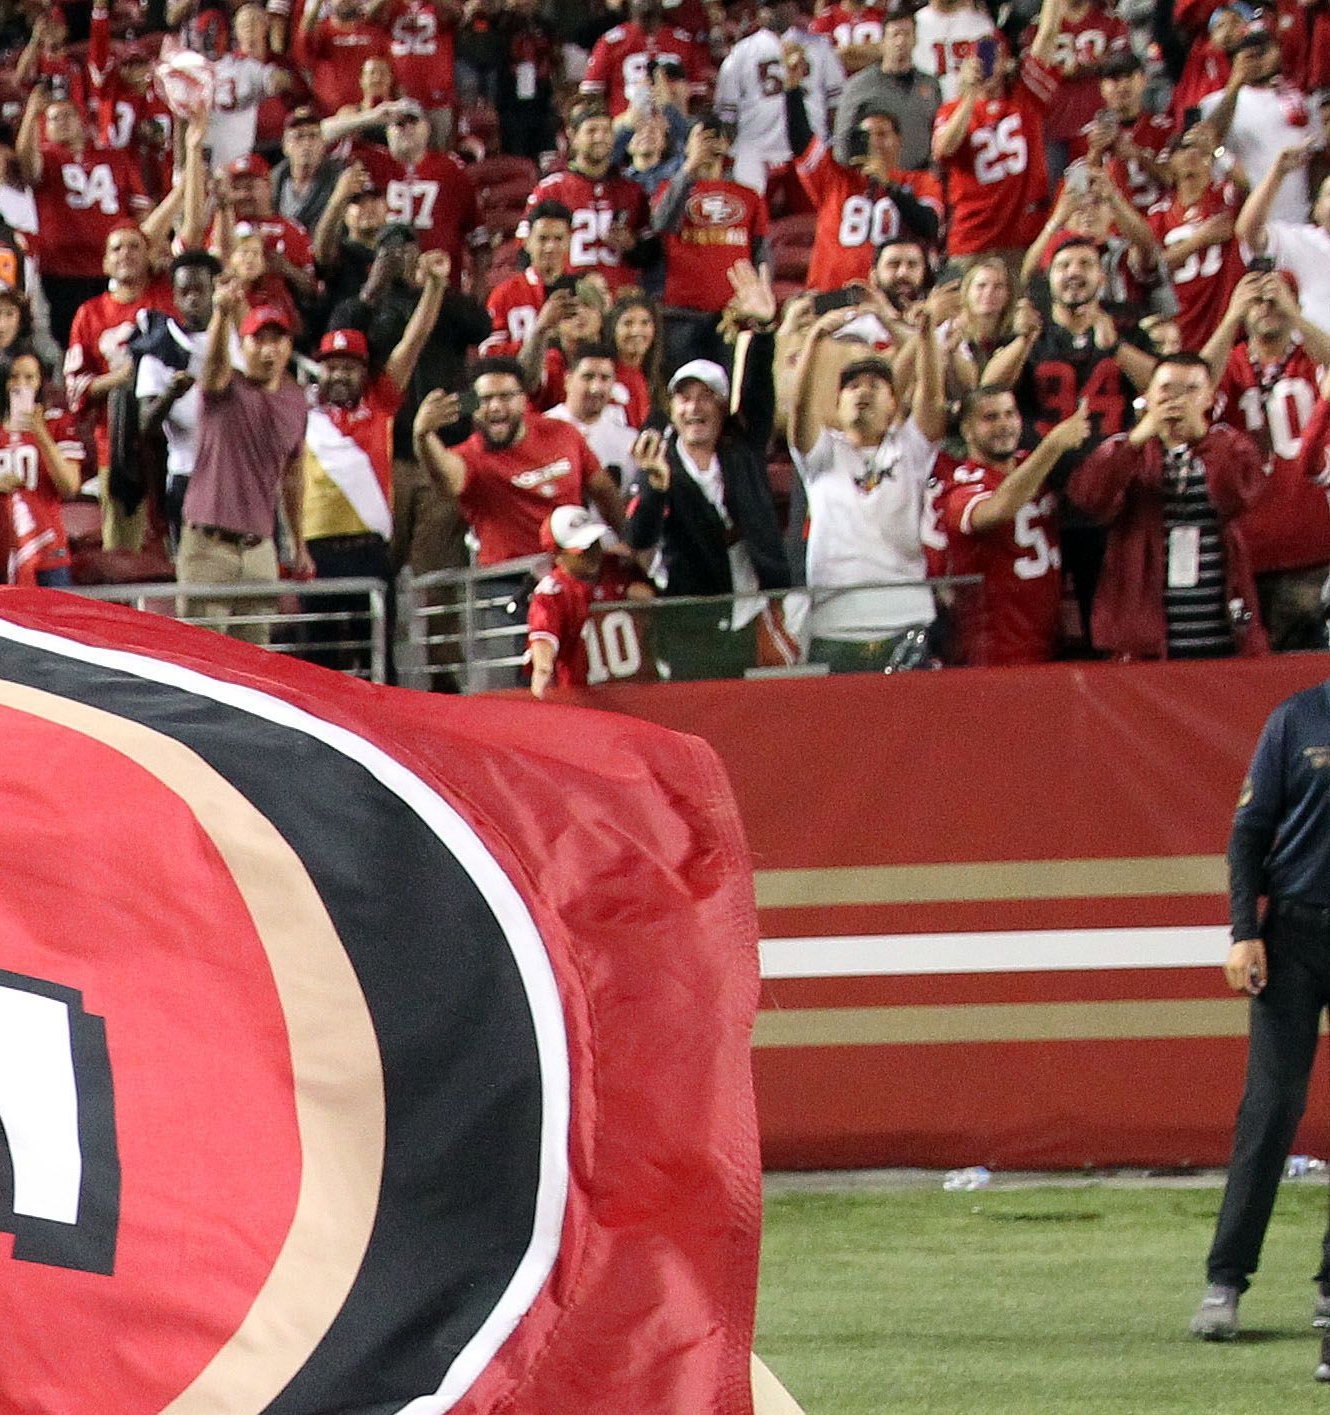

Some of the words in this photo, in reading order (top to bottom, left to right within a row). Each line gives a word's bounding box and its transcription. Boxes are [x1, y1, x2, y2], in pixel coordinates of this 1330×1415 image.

[971, 113, 1028, 185] 25
[61, 163, 118, 215] 94
[387, 180, 440, 229] 97
[838, 195, 900, 247] 80
[1239, 377, 1316, 459] 10
[580, 610, 642, 685] 10
